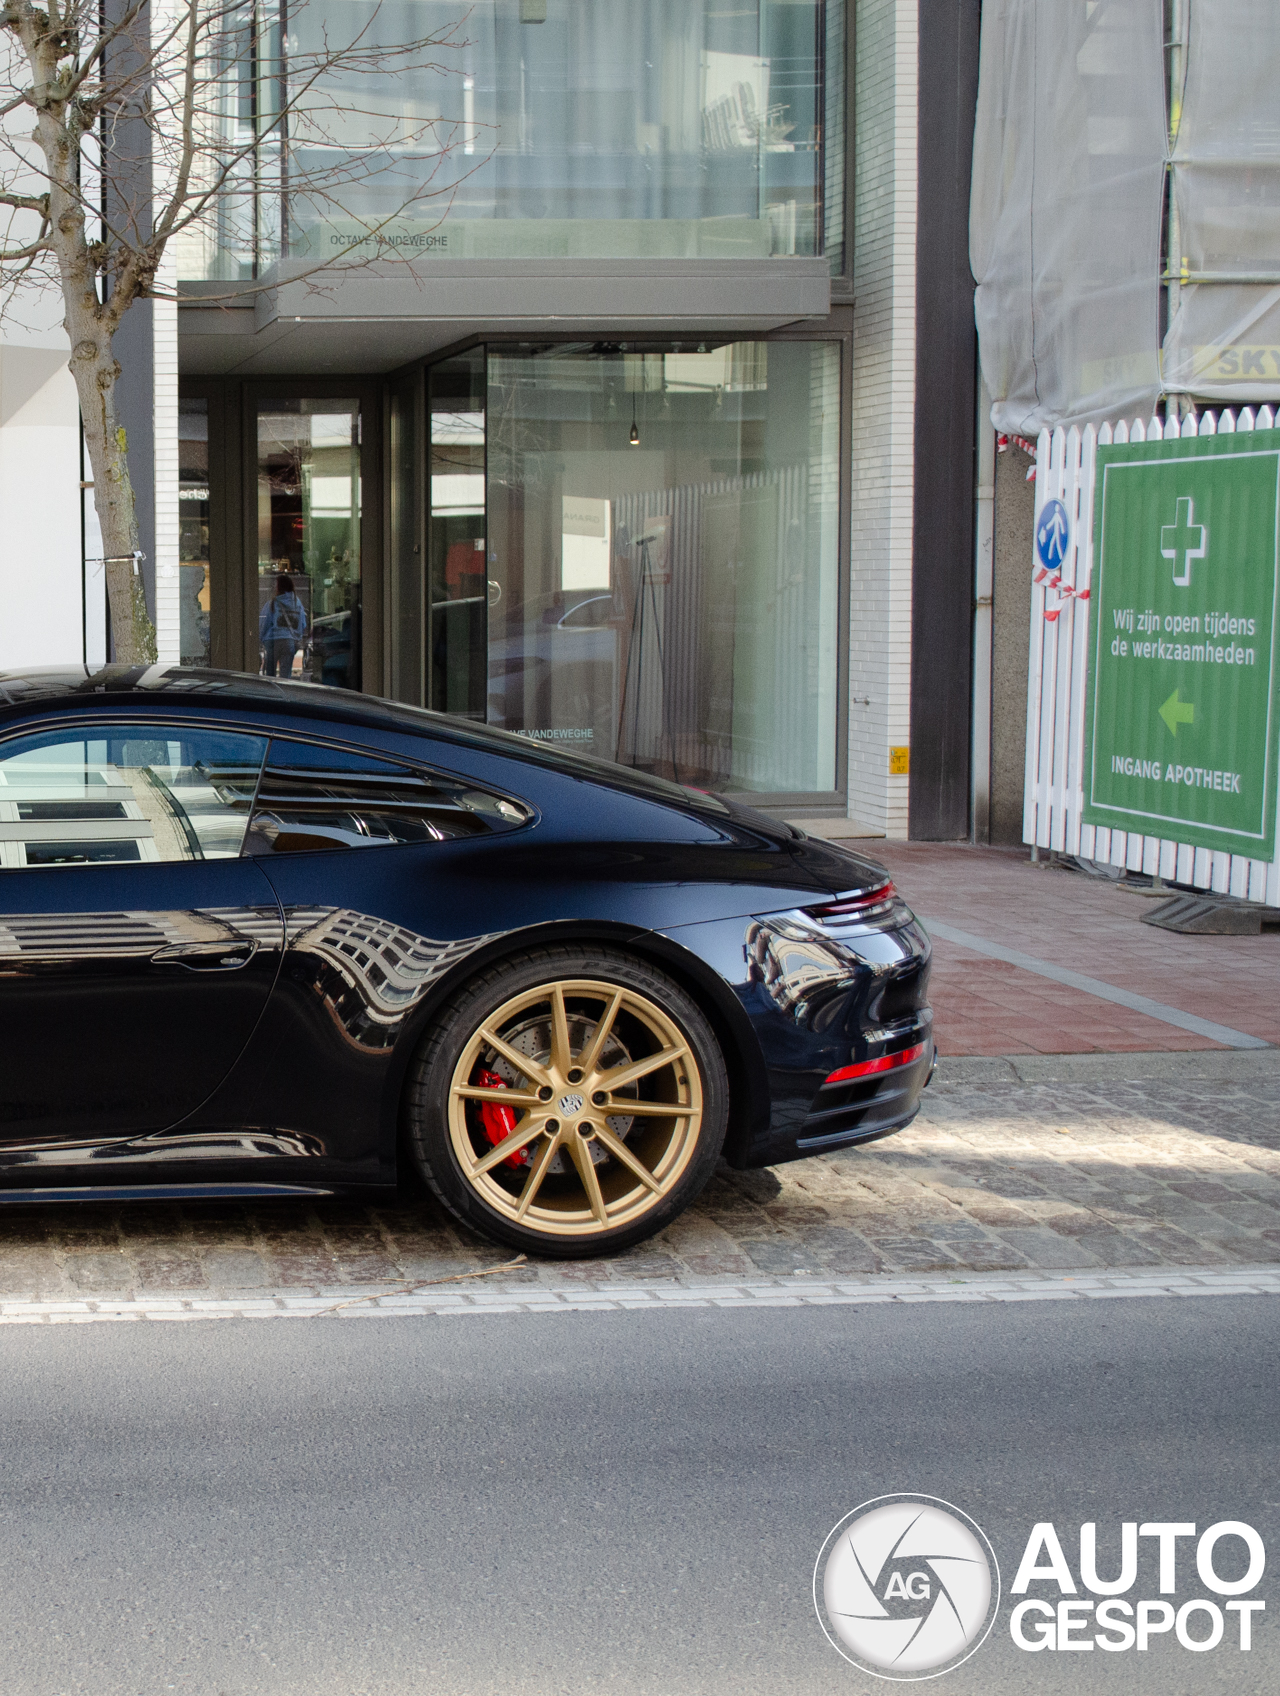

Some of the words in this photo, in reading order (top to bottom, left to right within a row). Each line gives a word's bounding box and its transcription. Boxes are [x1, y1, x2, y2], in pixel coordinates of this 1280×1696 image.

[330, 234, 371, 246] OCTAVE
[375, 235, 448, 247] VANDEWEGHE
[1113, 609, 1133, 633] Wij
[1137, 610, 1160, 634] zijn
[1164, 615, 1200, 636] open
[1204, 612, 1255, 638] tijdens
[1111, 635, 1128, 657] de
[1132, 638, 1255, 665] werkzaamheden
[528, 728, 593, 738] VANDEWEGHE
[1111, 755, 1161, 780] INGANG
[1165, 764, 1240, 793] APOTHEEK
[582, 961, 600, 970] P
[604, 964, 672, 999] ZERO
